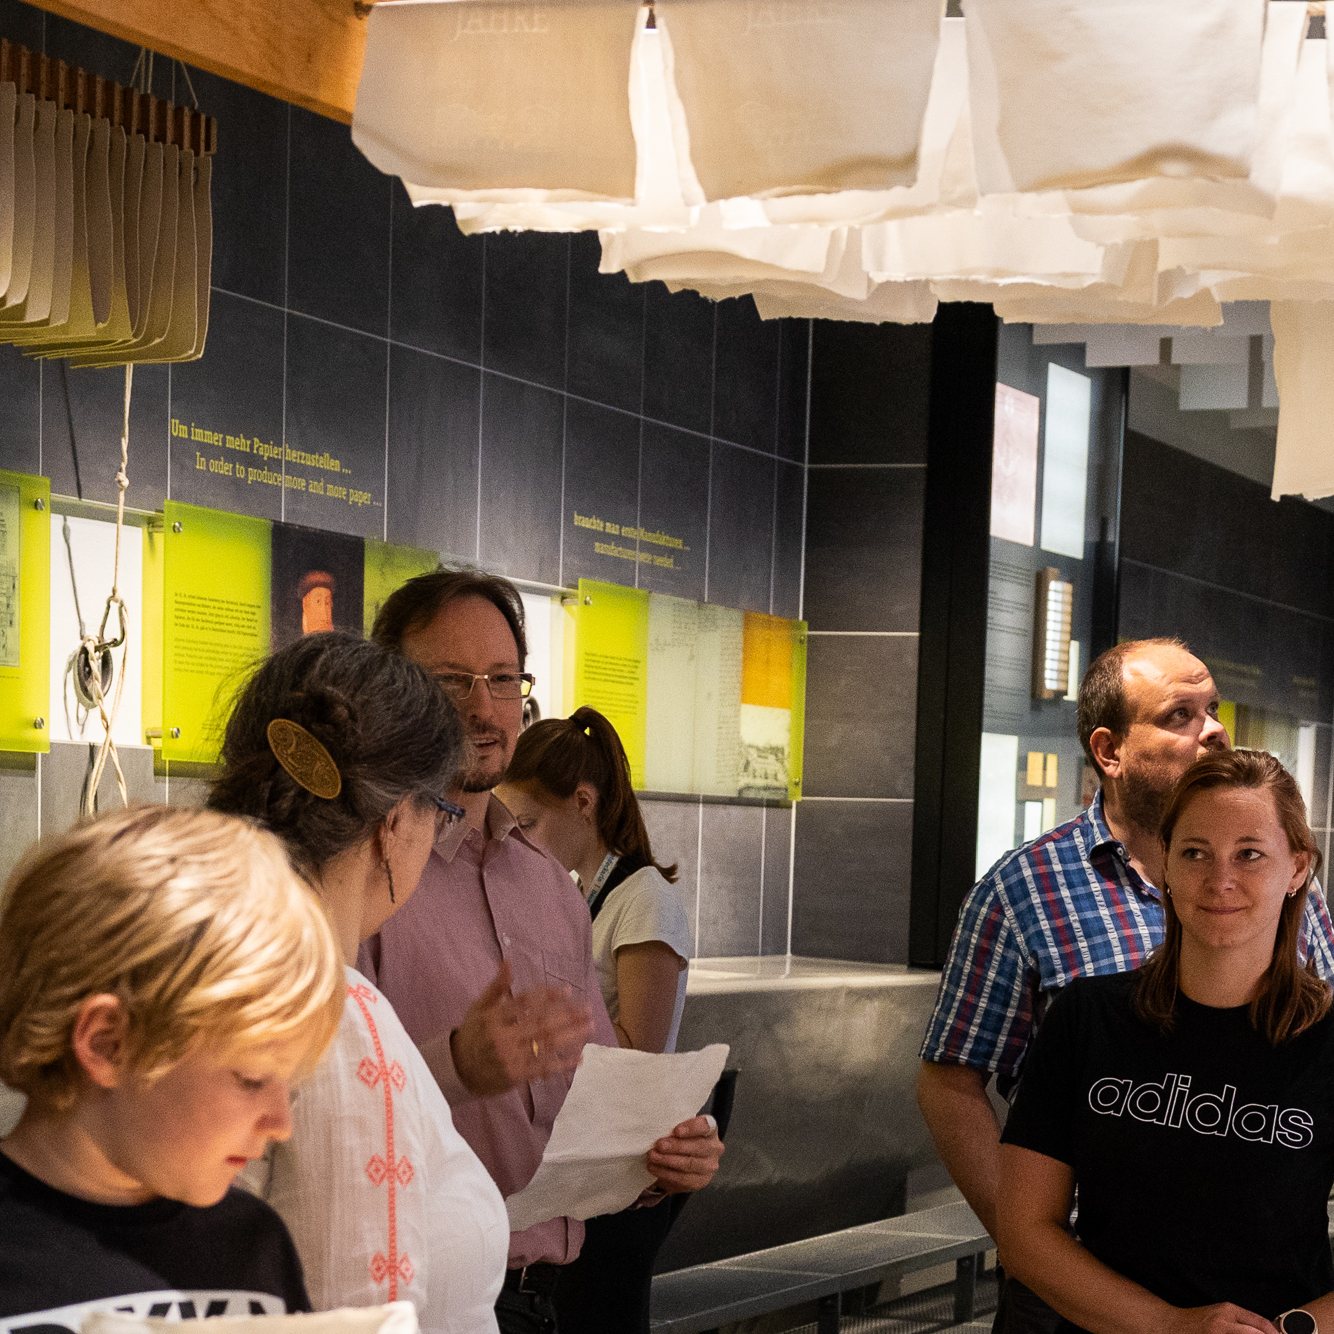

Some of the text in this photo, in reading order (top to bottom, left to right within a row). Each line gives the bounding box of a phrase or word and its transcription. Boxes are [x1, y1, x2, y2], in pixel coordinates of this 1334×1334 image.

[170, 418, 188, 439] Um
[190, 422, 223, 448] immer
[225, 433, 251, 453] mehr
[253, 437, 283, 461] Papier
[285, 443, 340, 473] herzustellen
[195, 451, 207, 470] In
[209, 456, 233, 476] order
[235, 461, 245, 479] to
[247, 465, 282, 485] produce
[284, 475, 306, 491] more
[308, 479, 324, 495] and
[326, 483, 346, 499] more
[348, 488, 371, 507] paper
[605, 521, 620, 535] man
[1088, 1072, 1314, 1149] adidas
